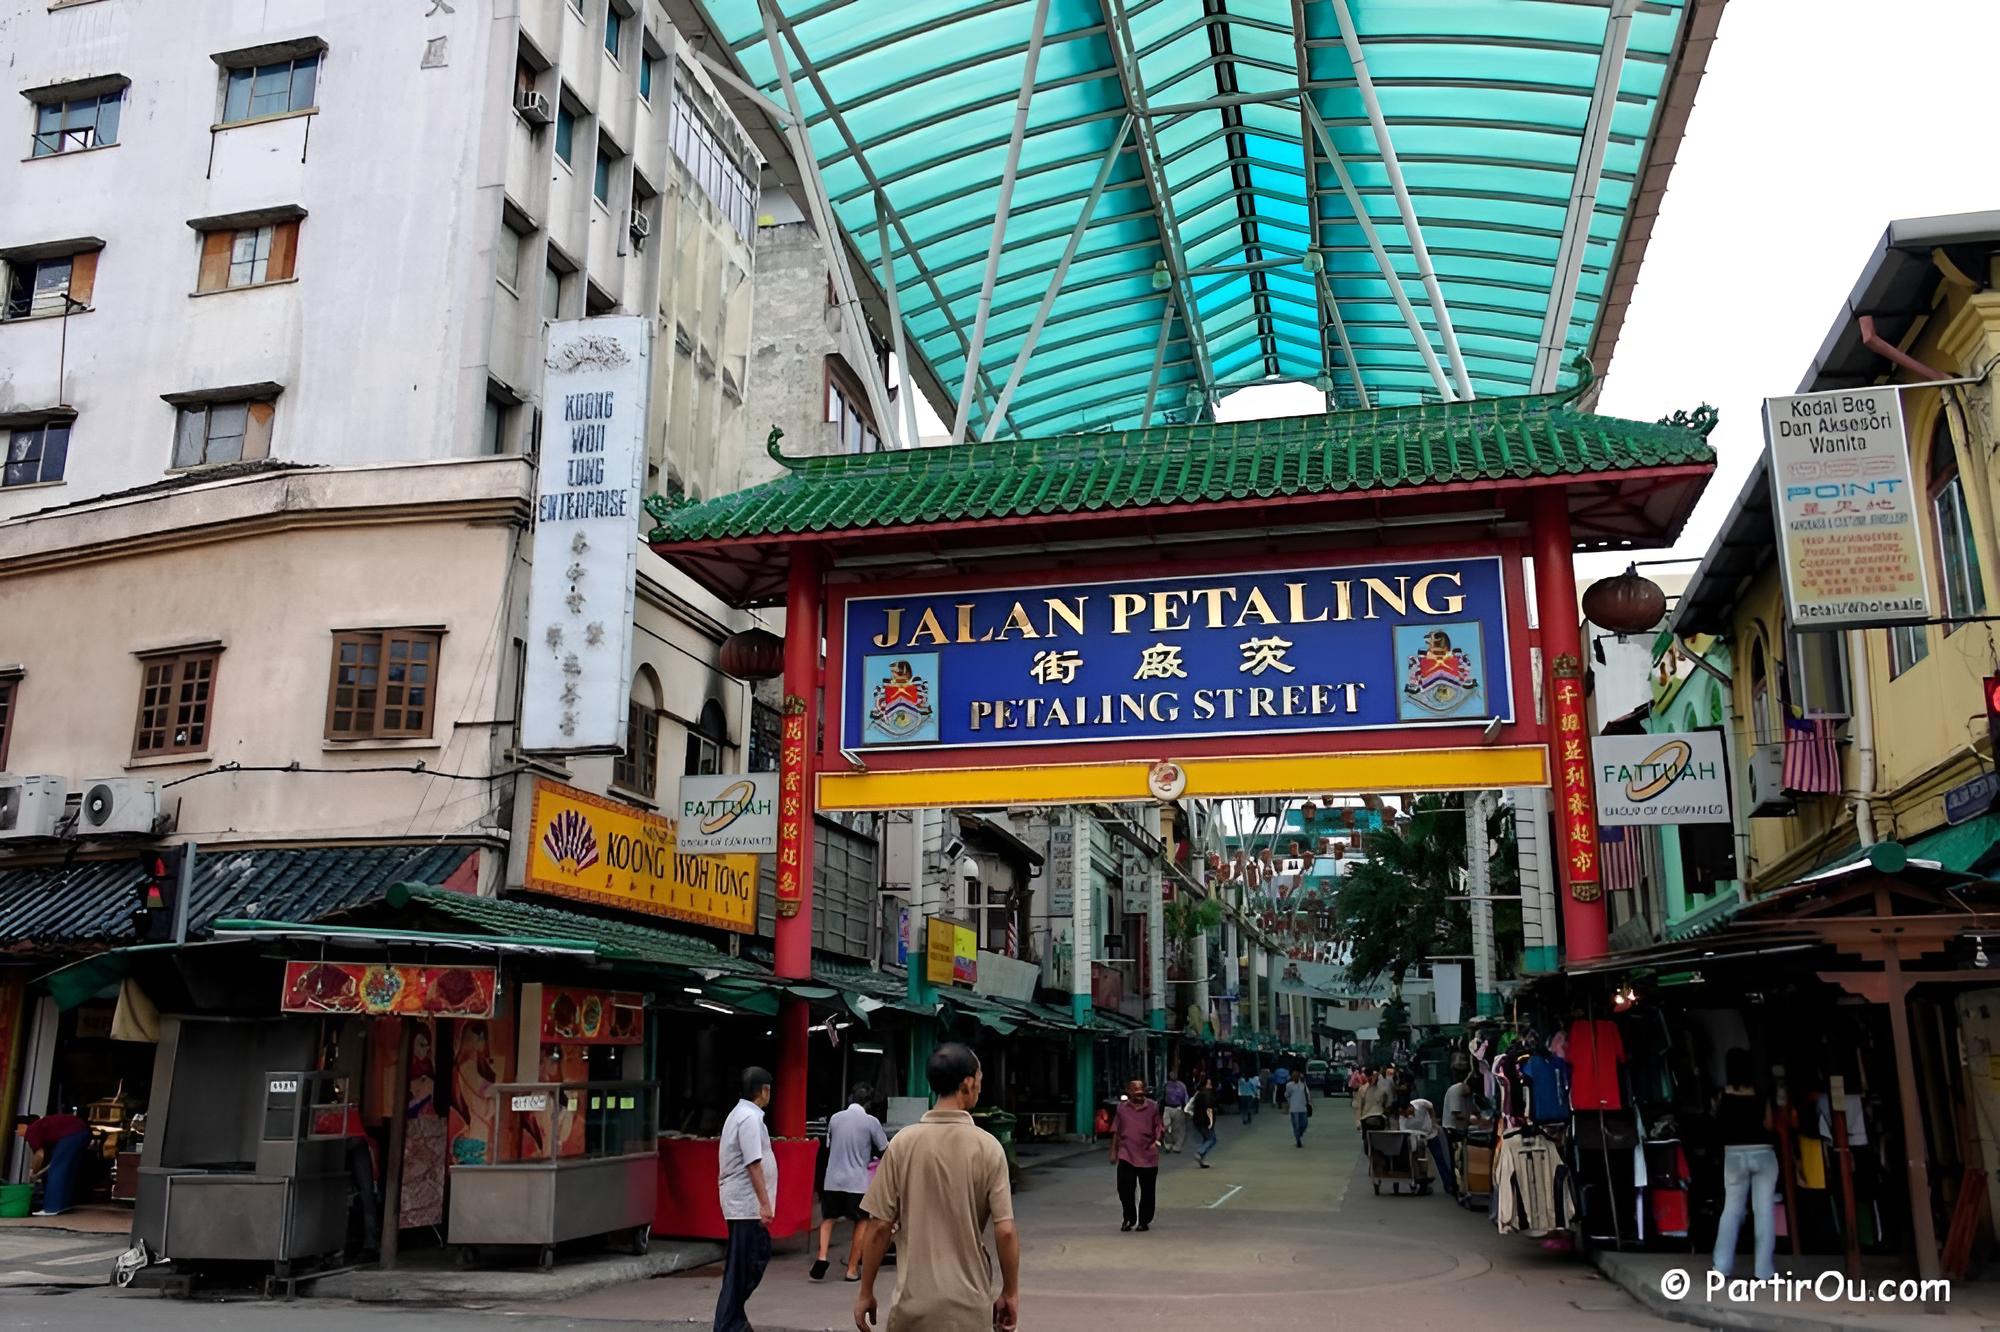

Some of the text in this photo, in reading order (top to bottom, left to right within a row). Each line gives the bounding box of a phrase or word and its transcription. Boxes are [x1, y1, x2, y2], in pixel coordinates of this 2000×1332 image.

[1780, 420, 1812, 437] Dan
[539, 489, 628, 522] ENTERPRISE
[873, 572, 1466, 650] JALAN PETALING
[969, 681, 1366, 731] PETALING STREET
[607, 832, 665, 879] KOONG
[714, 864, 750, 900] TONG
